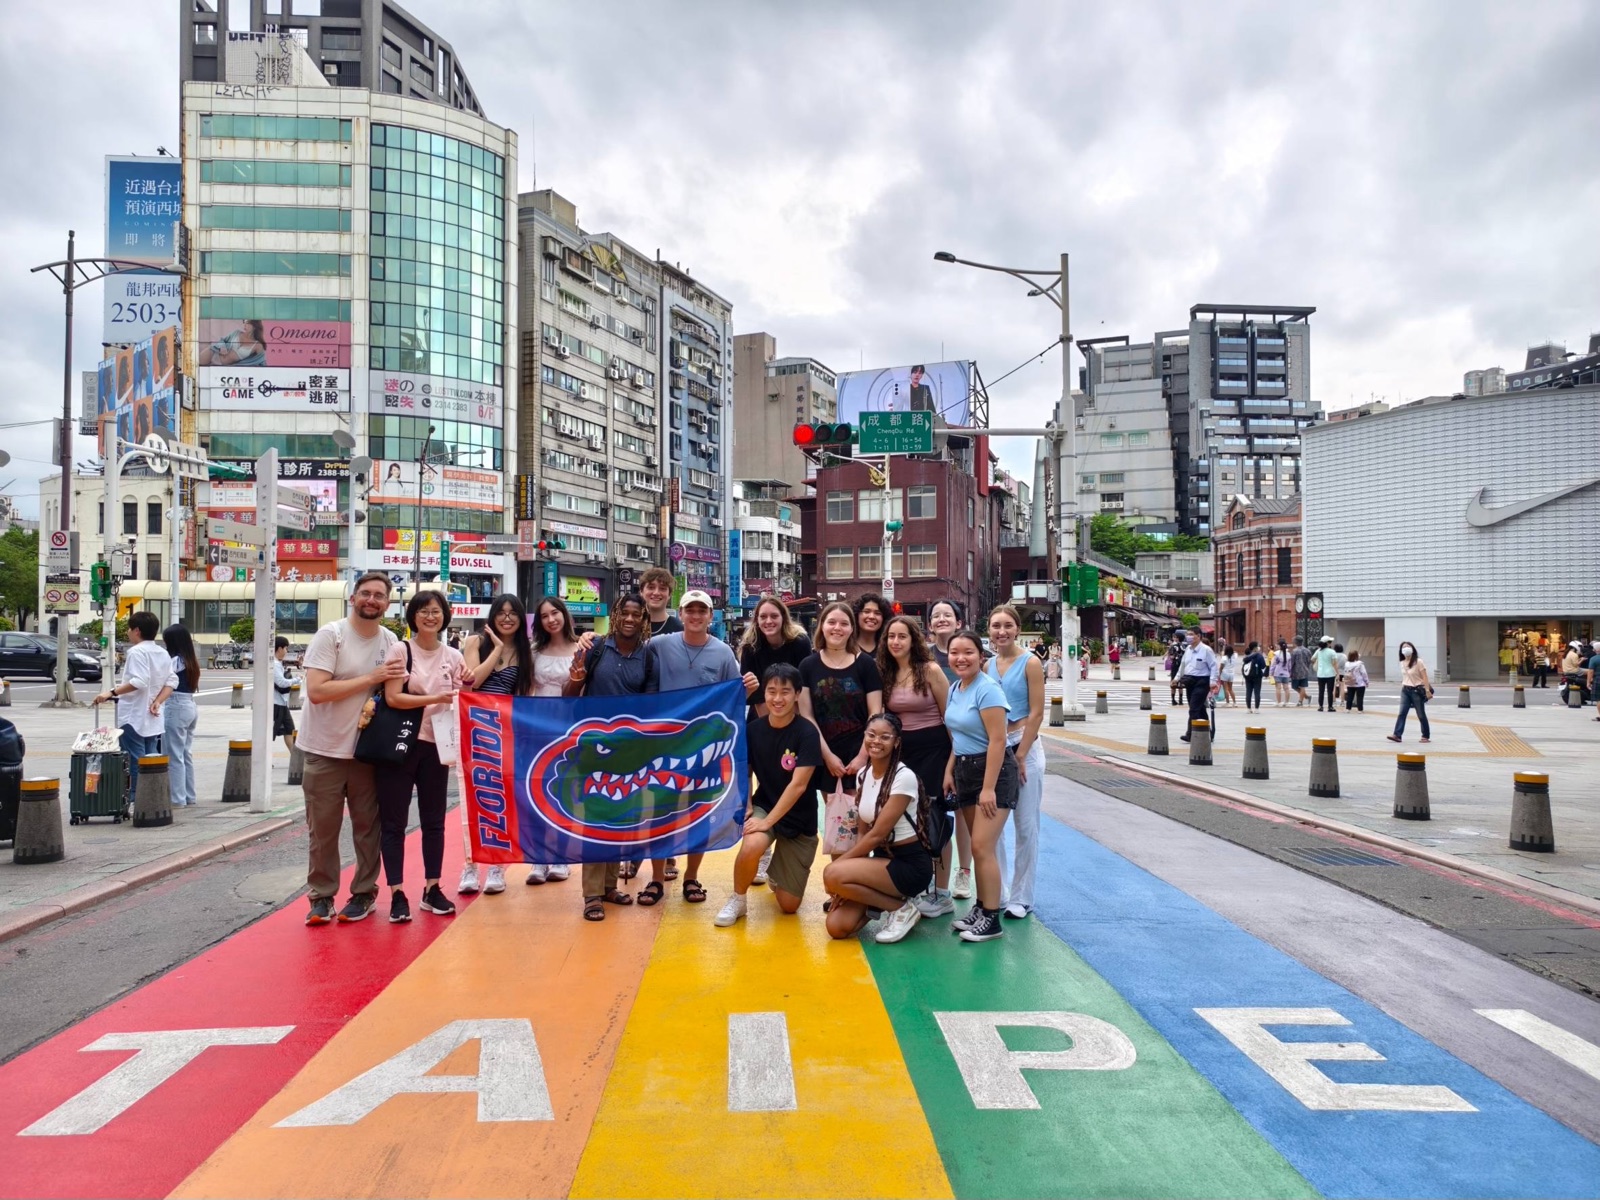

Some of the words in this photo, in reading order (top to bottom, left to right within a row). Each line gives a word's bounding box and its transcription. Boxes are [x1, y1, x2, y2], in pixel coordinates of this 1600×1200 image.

[270, 326, 337, 344] Qmomo
[309, 375, 338, 389] 密室
[222, 388, 254, 399] GAME
[309, 390, 338, 404] 逃脫
[867, 413, 924, 427] 成都路
[318, 469, 358, 477] 2388-88
[450, 607, 481, 615] TREET
[468, 705, 512, 852] FLORIDA
